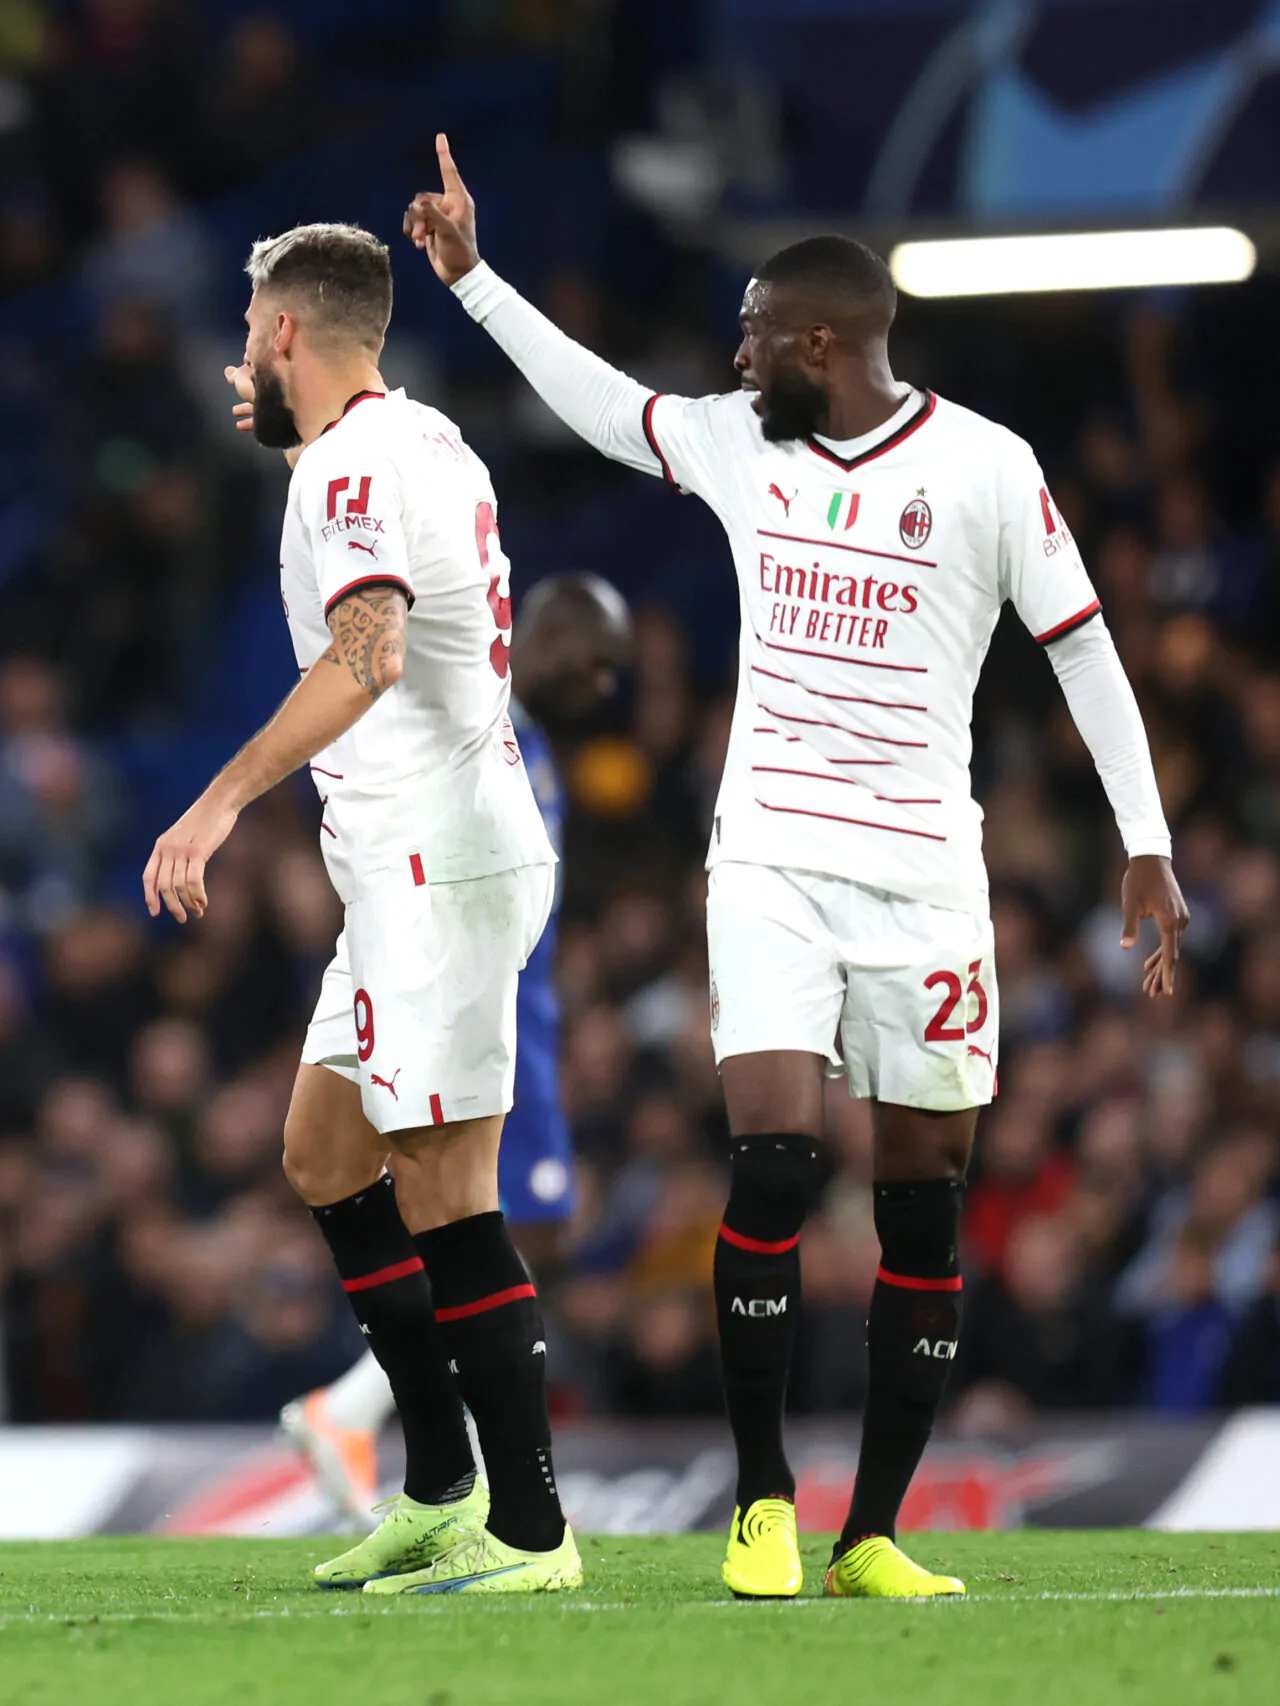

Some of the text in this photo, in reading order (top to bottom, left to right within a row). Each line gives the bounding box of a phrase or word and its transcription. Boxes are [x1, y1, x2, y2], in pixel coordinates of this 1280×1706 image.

[321, 515, 385, 543] BitMEX
[760, 552, 919, 614] Emirates
[770, 602, 888, 649] FLY BETTER
[923, 957, 988, 1042] 23
[354, 988, 375, 1062] 9
[731, 1294, 788, 1317] ACM
[414, 1515, 459, 1545] ULTRA
